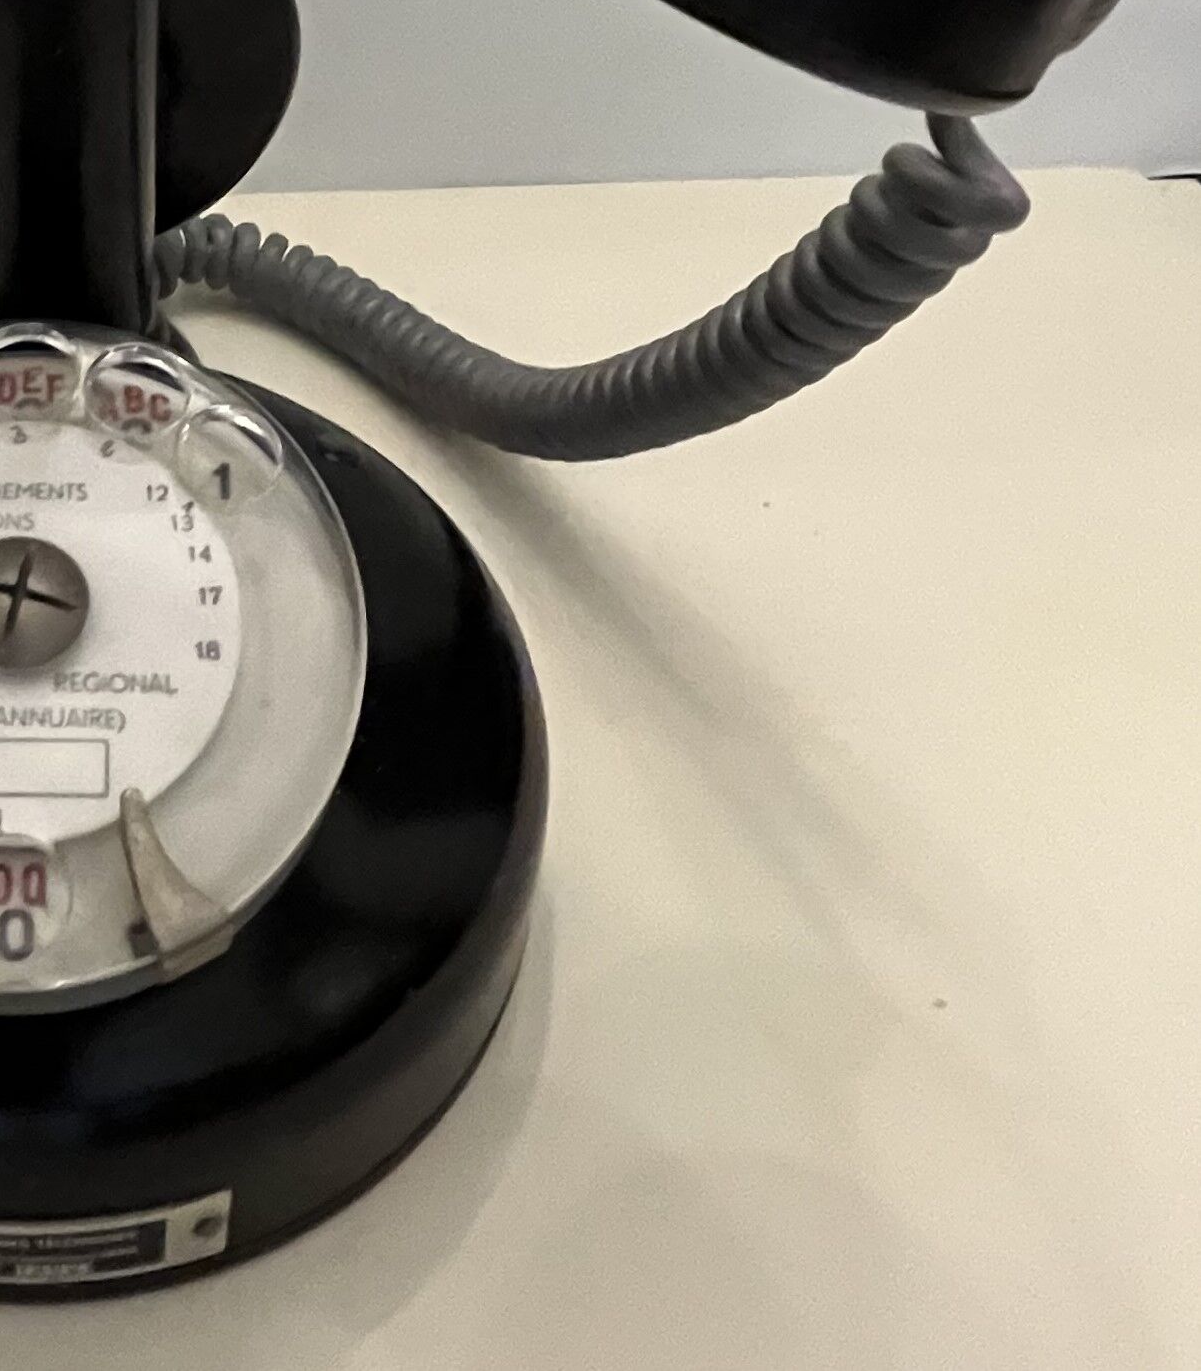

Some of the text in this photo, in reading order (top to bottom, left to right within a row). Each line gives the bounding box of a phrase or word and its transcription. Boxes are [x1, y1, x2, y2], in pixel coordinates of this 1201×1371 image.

[212, 461, 231, 501] 1
[146, 483, 169, 502] 12
[170, 514, 195, 532] 13
[187, 544, 212, 563] 14
[197, 585, 223, 607] 17
[194, 639, 222, 662] 18
[52, 671, 179, 696] REGIONAL
